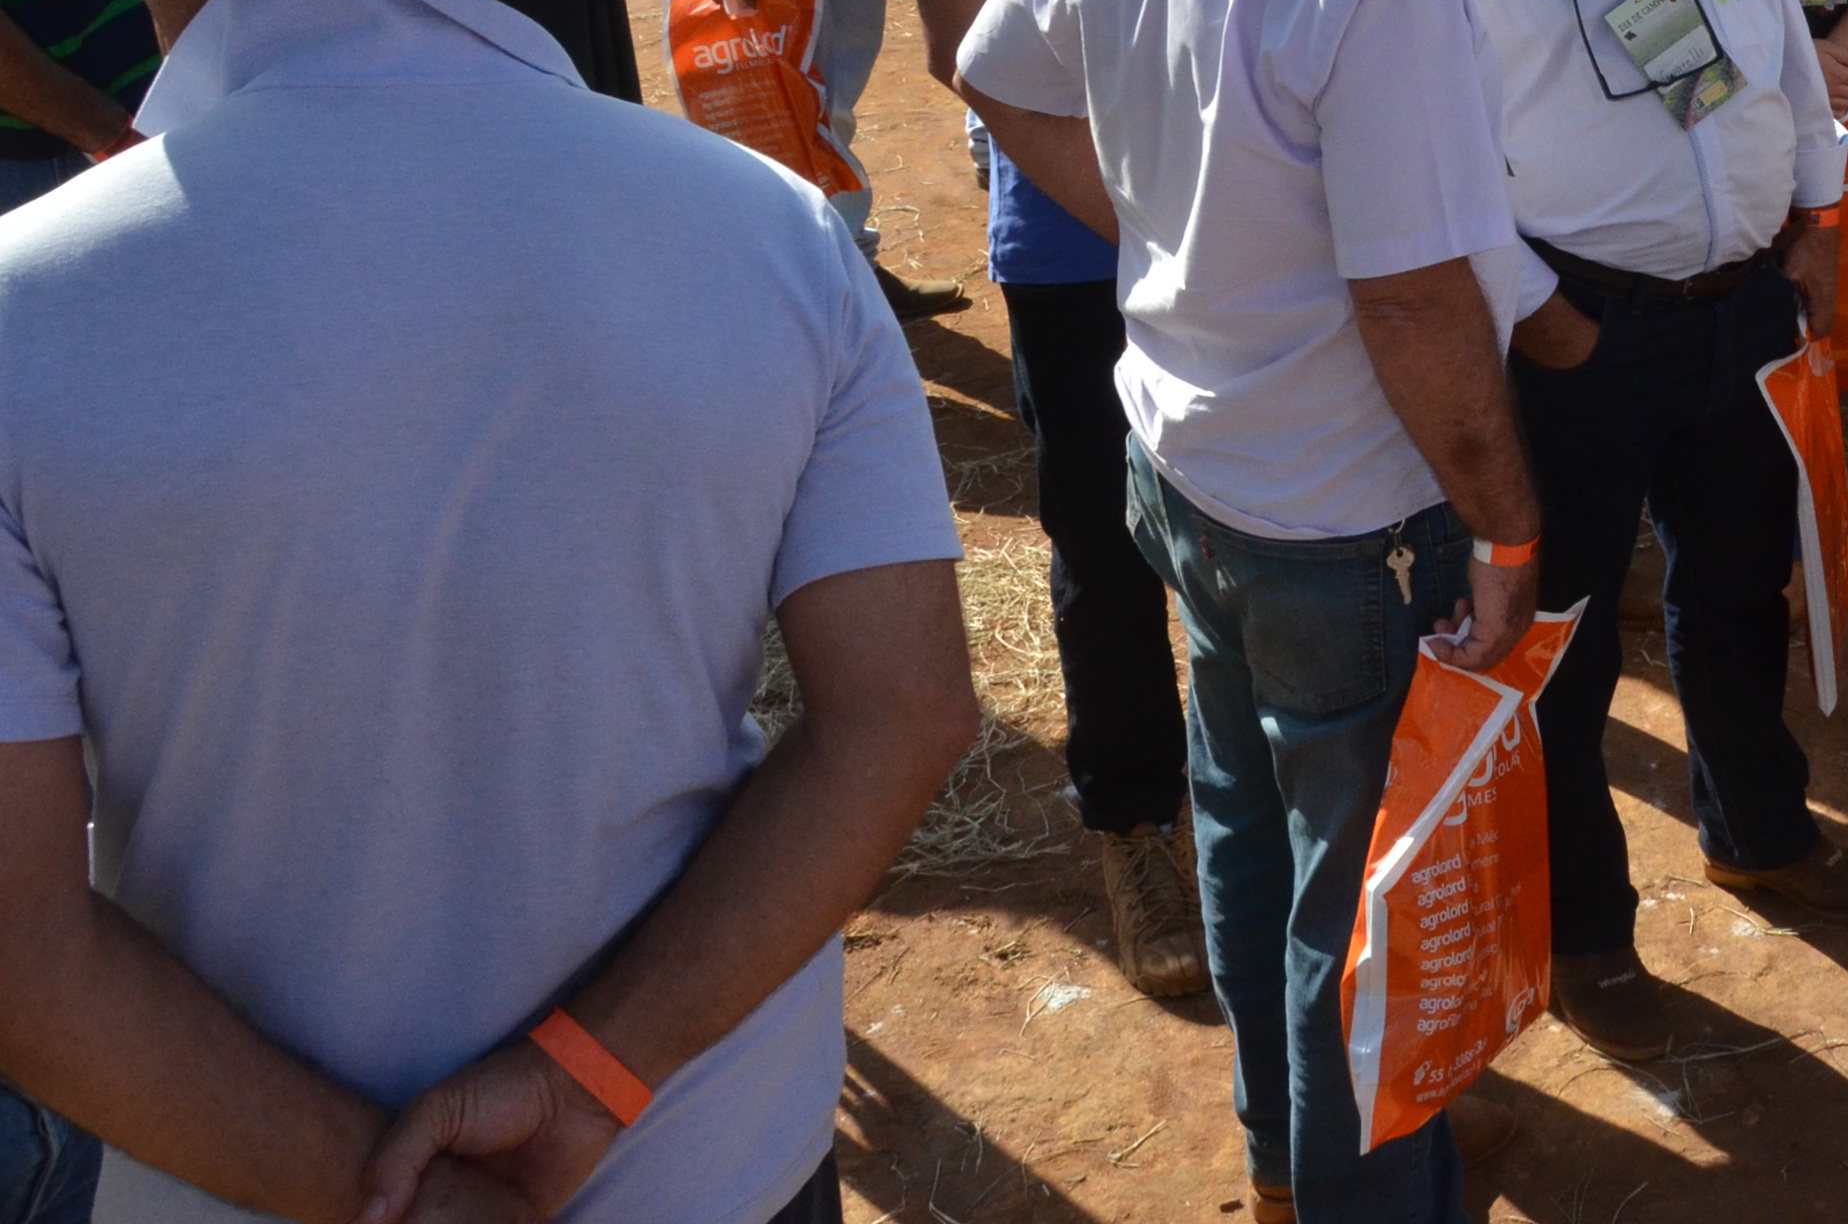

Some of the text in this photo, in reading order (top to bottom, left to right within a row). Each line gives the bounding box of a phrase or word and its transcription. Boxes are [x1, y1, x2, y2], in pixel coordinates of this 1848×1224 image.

[1412, 853, 1462, 885] agrolord
[1418, 876, 1466, 908] agrolord
[1420, 899, 1470, 930] agrolord
[1421, 922, 1471, 952] agrolord
